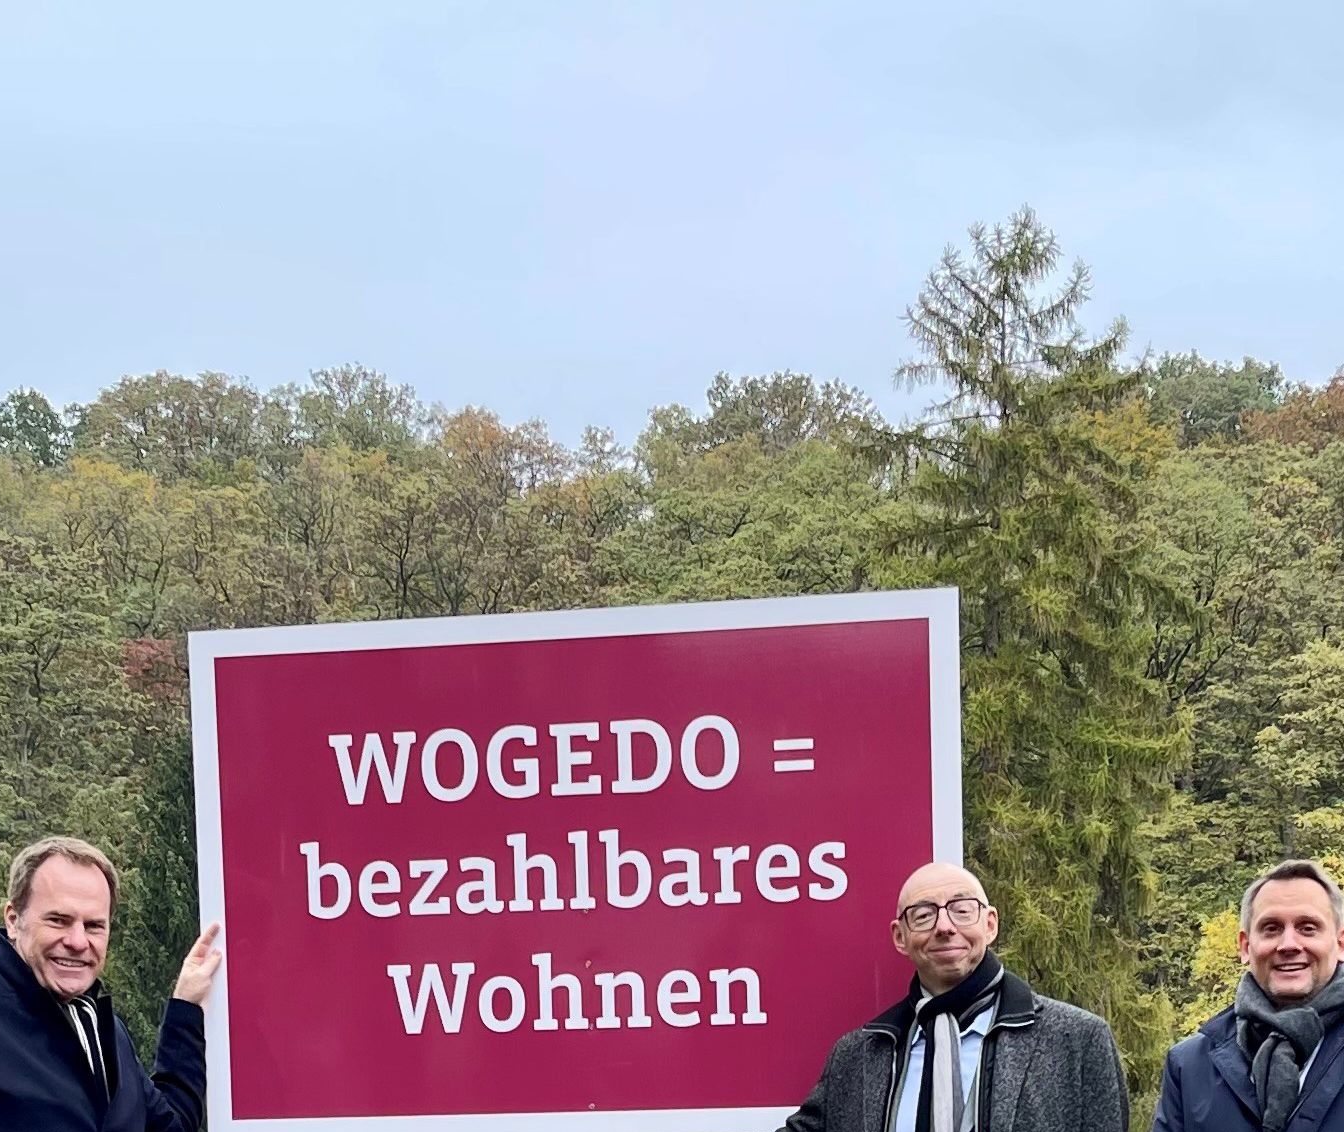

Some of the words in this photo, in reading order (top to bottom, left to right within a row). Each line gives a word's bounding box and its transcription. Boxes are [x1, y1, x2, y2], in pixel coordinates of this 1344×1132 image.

[329, 714, 740, 805] WOGEDO
[773, 738, 815, 772] =
[299, 828, 848, 920] bezahlbares
[387, 952, 768, 1035] Wohnen
